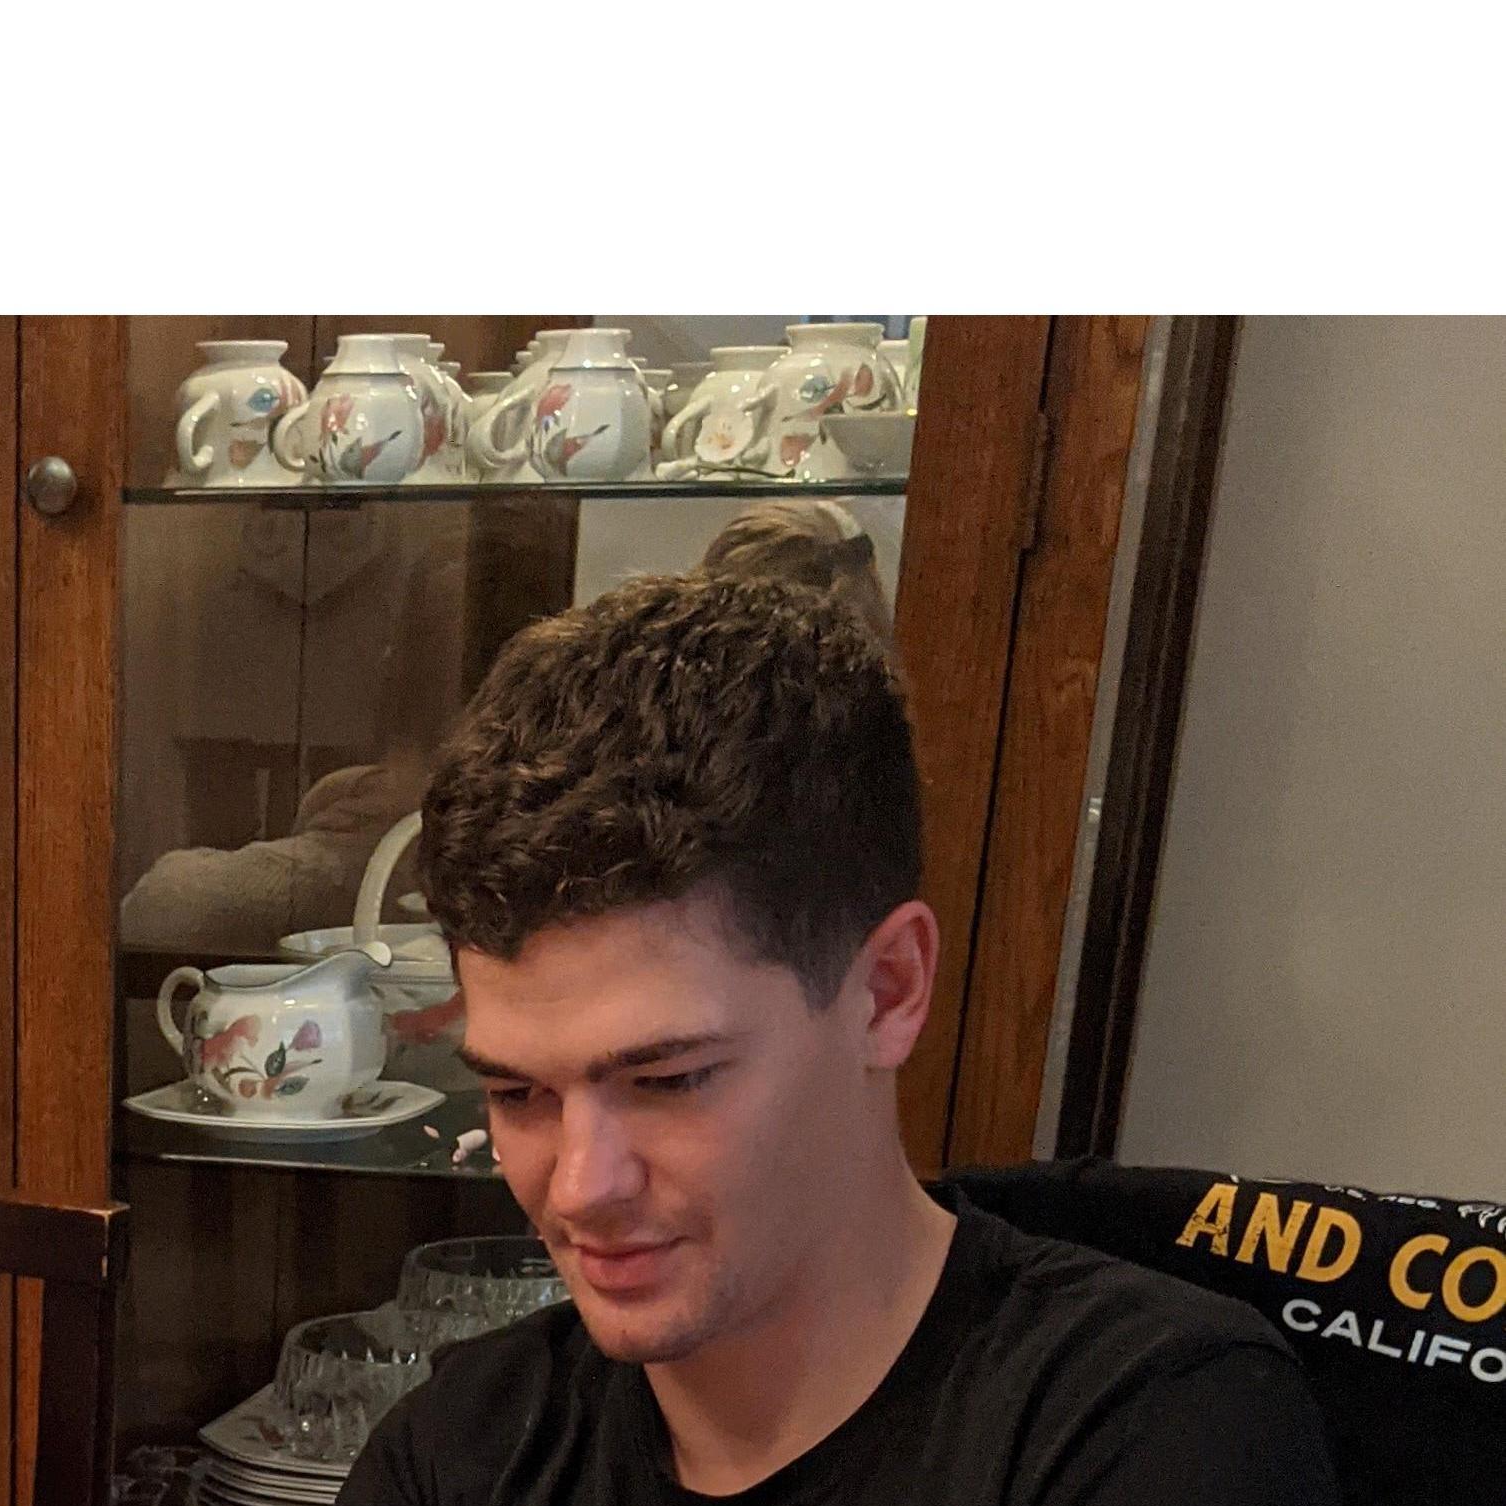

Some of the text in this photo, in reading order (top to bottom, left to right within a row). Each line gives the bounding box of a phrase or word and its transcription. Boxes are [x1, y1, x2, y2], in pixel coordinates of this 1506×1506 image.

[1175, 1182, 1506, 1323] AND CO
[1282, 1298, 1506, 1382] CALIFO
